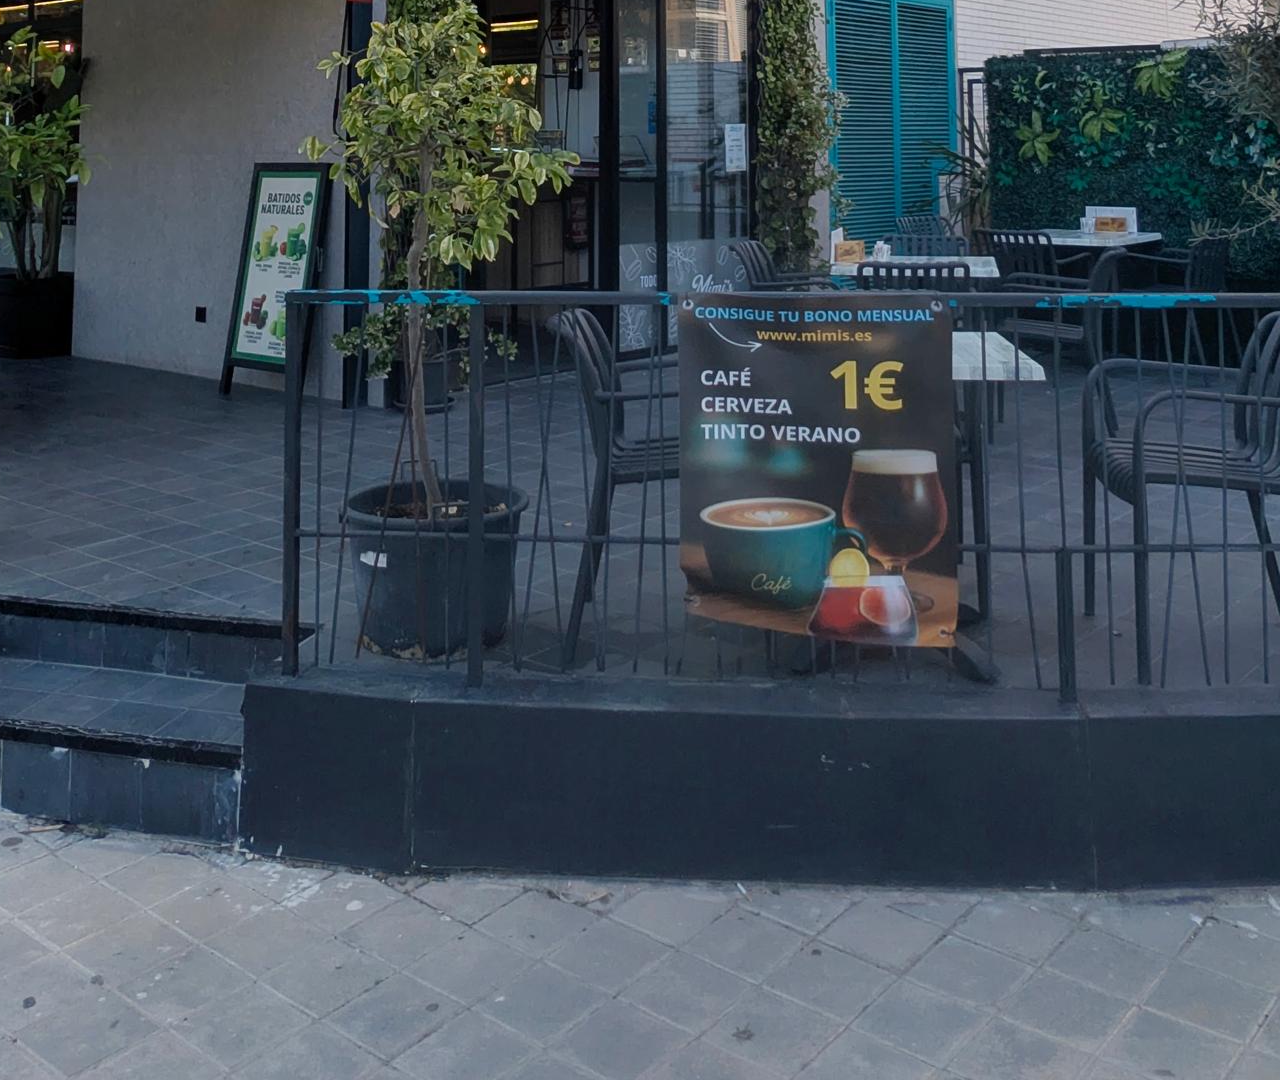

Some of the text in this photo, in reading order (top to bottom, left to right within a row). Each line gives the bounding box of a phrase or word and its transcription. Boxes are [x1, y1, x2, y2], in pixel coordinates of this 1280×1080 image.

[267, 193, 301, 204] BATIDOS
[261, 204, 305, 215] NATURALES
[695, 306, 934, 322] CONSIGUE TU BONO MENSUAL
[756, 328, 873, 342] www.mimis.es
[700, 367, 751, 386] CAFÉ
[830, 360, 904, 411] 1€
[700, 396, 792, 415] CERVEZA
[700, 423, 861, 443] TINTO VERANO
[751, 573, 792, 594] Café
